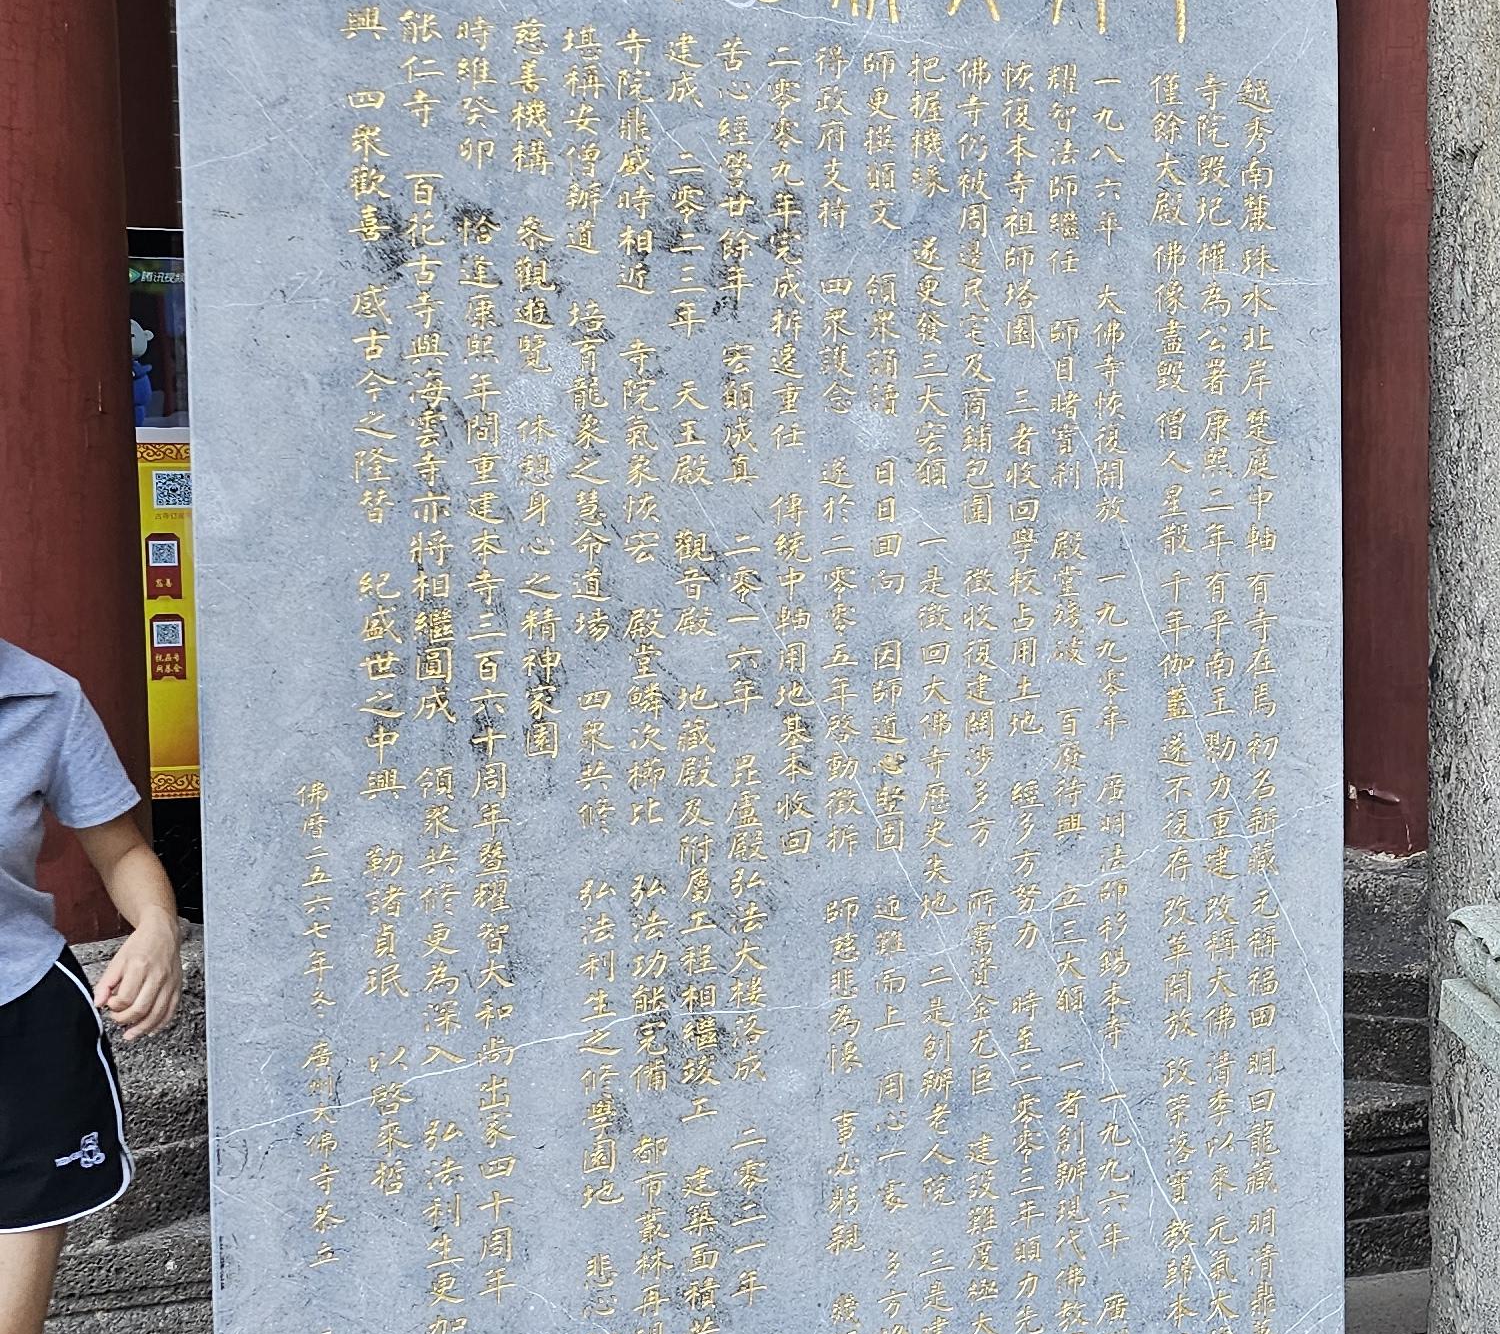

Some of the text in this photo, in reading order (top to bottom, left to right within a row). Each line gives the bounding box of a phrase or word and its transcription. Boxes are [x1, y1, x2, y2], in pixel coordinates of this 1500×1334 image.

[398, 7, 440, 126] 能仁寺
[456, 14, 495, 167] 時維癸卯
[510, 16, 550, 172] 慈善機構
[666, 30, 701, 104] 建成
[815, 42, 848, 227] 得政府支持
[1093, 75, 1124, 235] 一九八六年
[515, 213, 554, 374] 參觀遊覽
[670, 149, 704, 333] 二零二三年
[674, 378, 710, 486] 天王殿
[722, 342, 757, 483] 宏願成真
[341, 3, 385, 39] 興
[365, 846, 408, 996] 勒諸貞珉
[872, 458, 905, 593] 日日回向
[674, 527, 714, 636] 觀音殿
[724, 533, 761, 709] 二零一六年
[1052, 528, 1083, 663] 殿堂殘破
[1096, 571, 1125, 736] 一九九零年
[1055, 706, 1083, 838] 百廢待興
[1010, 778, 1040, 946] 經多方努力
[875, 895, 906, 1030] 迎難而上
[1055, 882, 1083, 1012] 立三大願
[733, 1127, 768, 1304] 二零二一年
[826, 1108, 859, 1254] 事必躬親
[1101, 1088, 1131, 1257] 一九九六年
